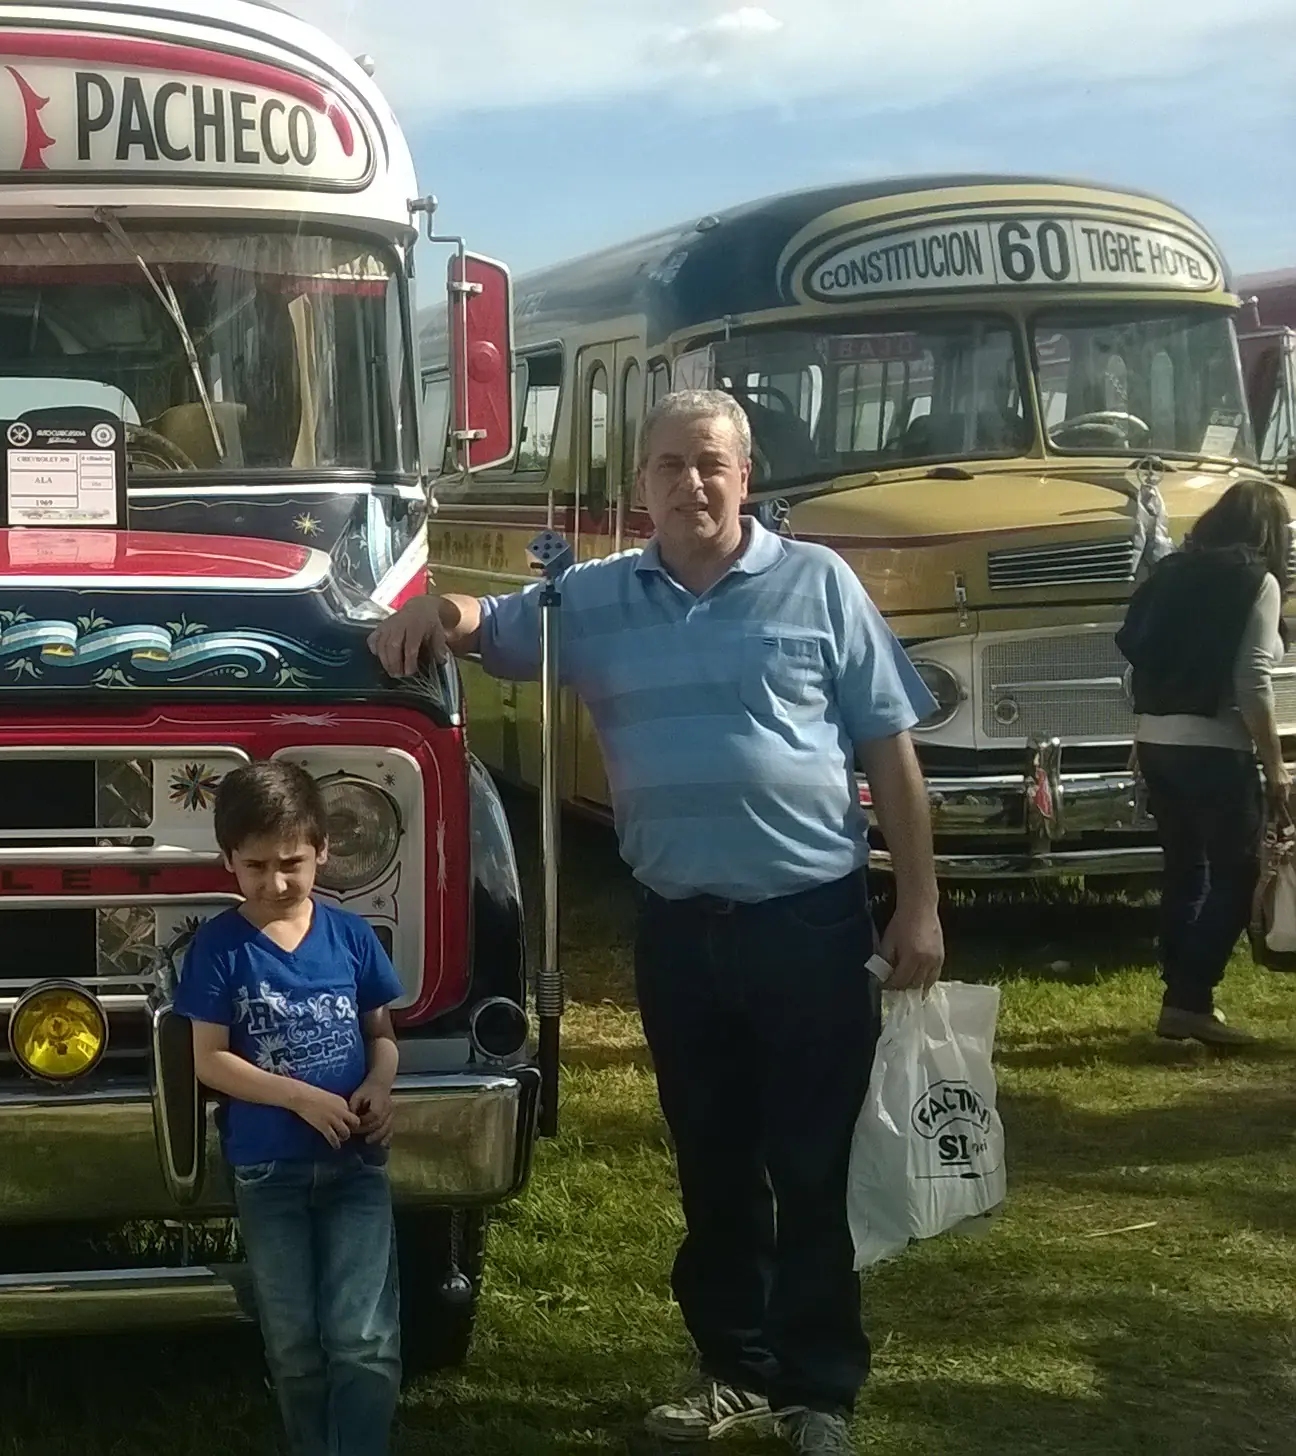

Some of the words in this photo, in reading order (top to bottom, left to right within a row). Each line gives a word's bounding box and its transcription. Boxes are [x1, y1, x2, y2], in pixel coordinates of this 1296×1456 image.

[76, 71, 317, 167] PACHECO
[819, 227, 983, 291] CONSTITUCION
[997, 220, 1071, 282] 60
[1081, 226, 1145, 275] TIGRE
[1150, 240, 1209, 282] HOTEL
[837, 337, 913, 358] BAJO
